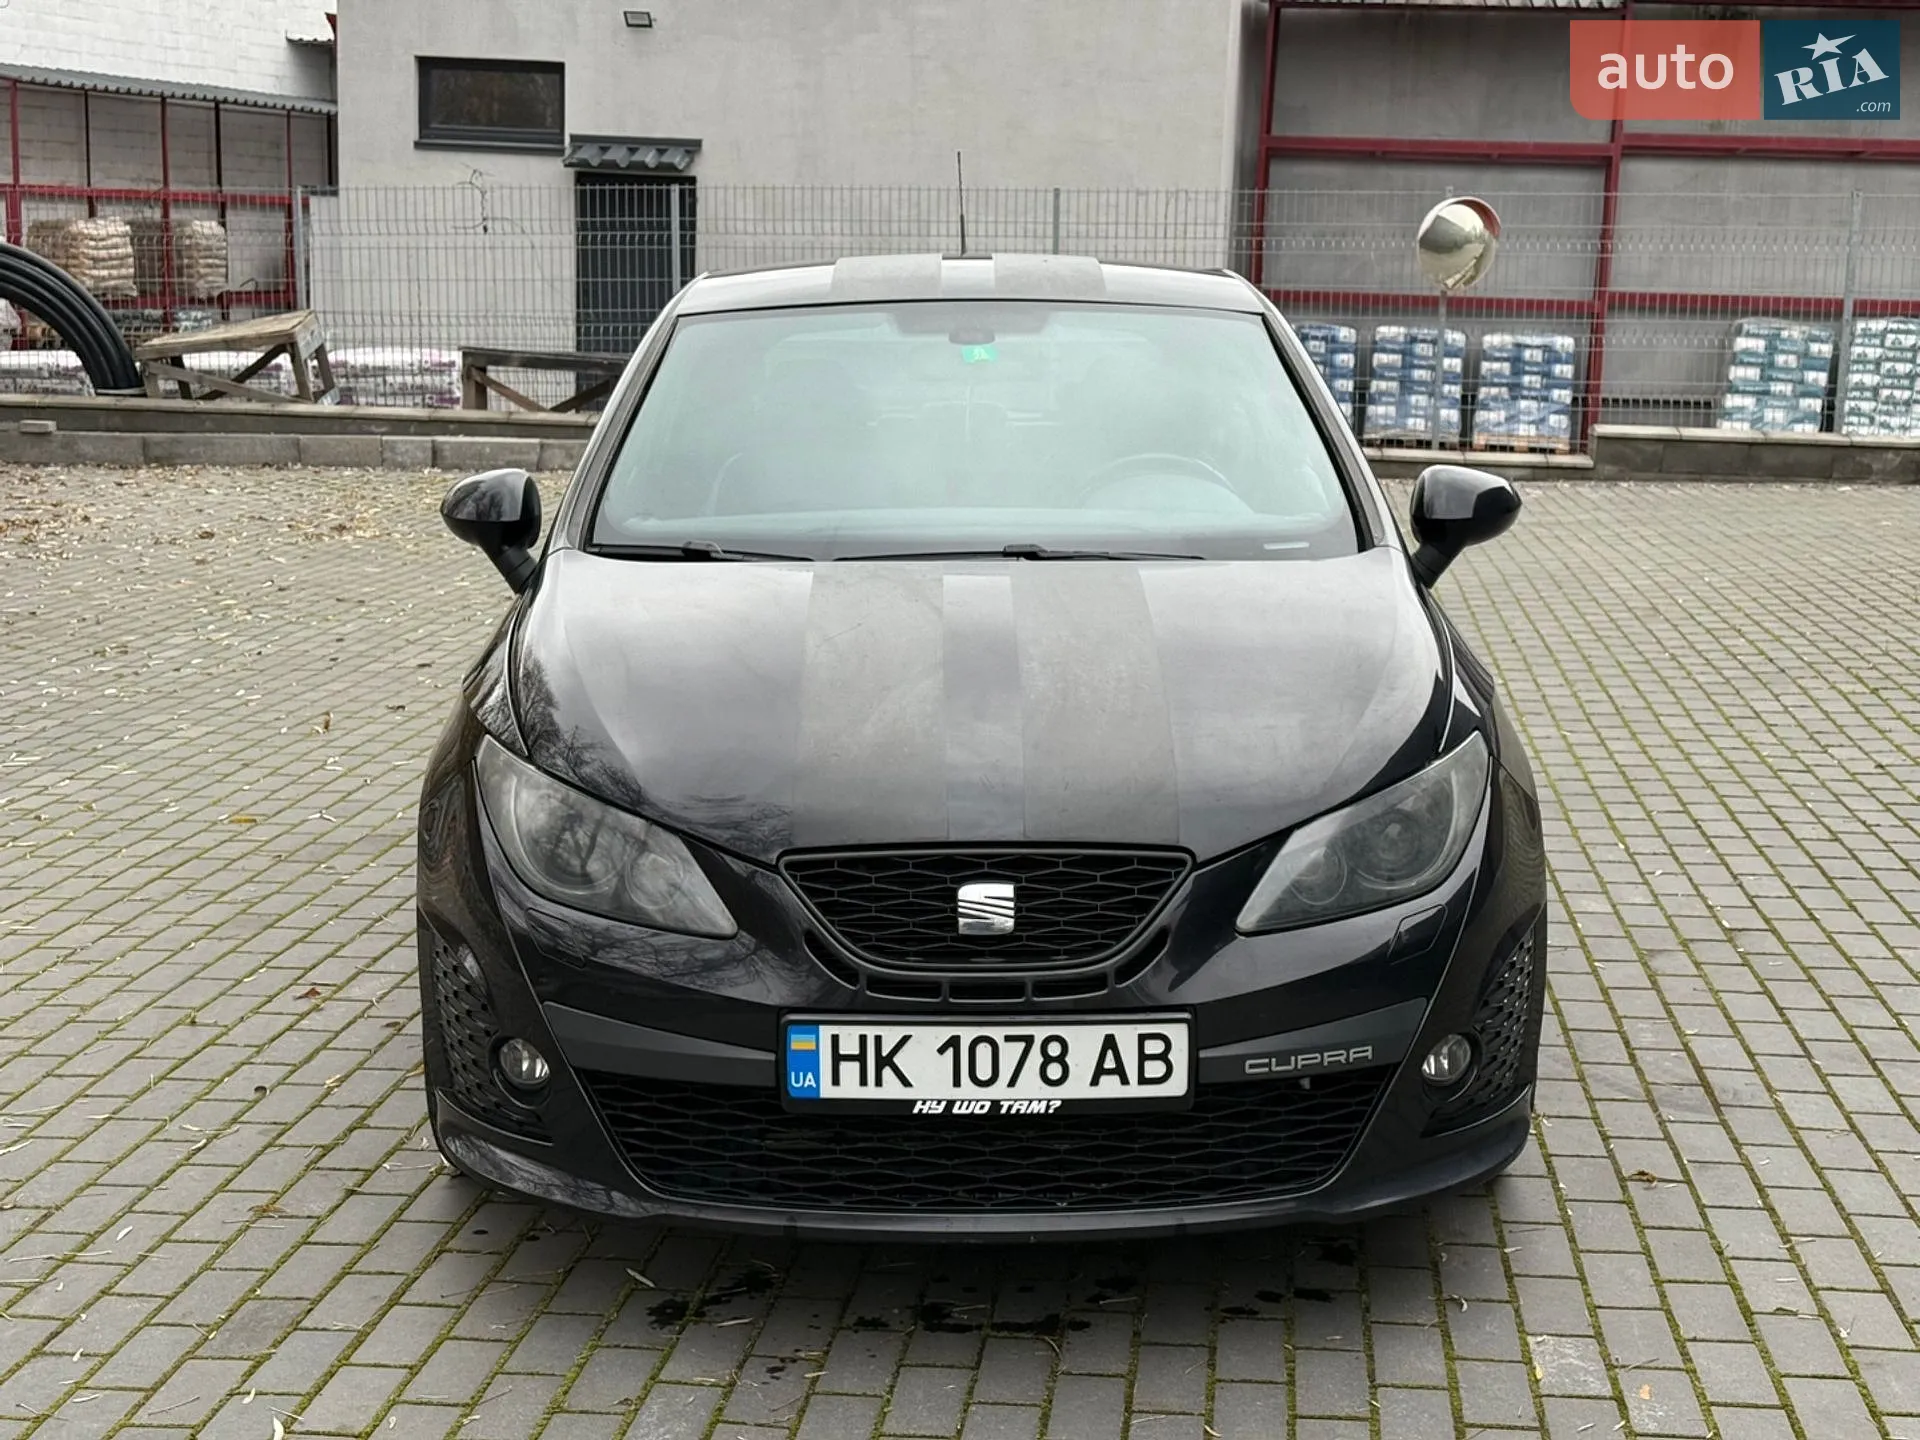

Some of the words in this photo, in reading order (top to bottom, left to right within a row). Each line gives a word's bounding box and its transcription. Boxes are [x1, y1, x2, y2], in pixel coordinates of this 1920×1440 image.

[830, 1033, 914, 1089] HK
[935, 1034, 1070, 1089] 1078
[1088, 1032, 1175, 1087] AB
[1244, 1045, 1374, 1075] CUPRA
[790, 1072, 817, 1089] UA
